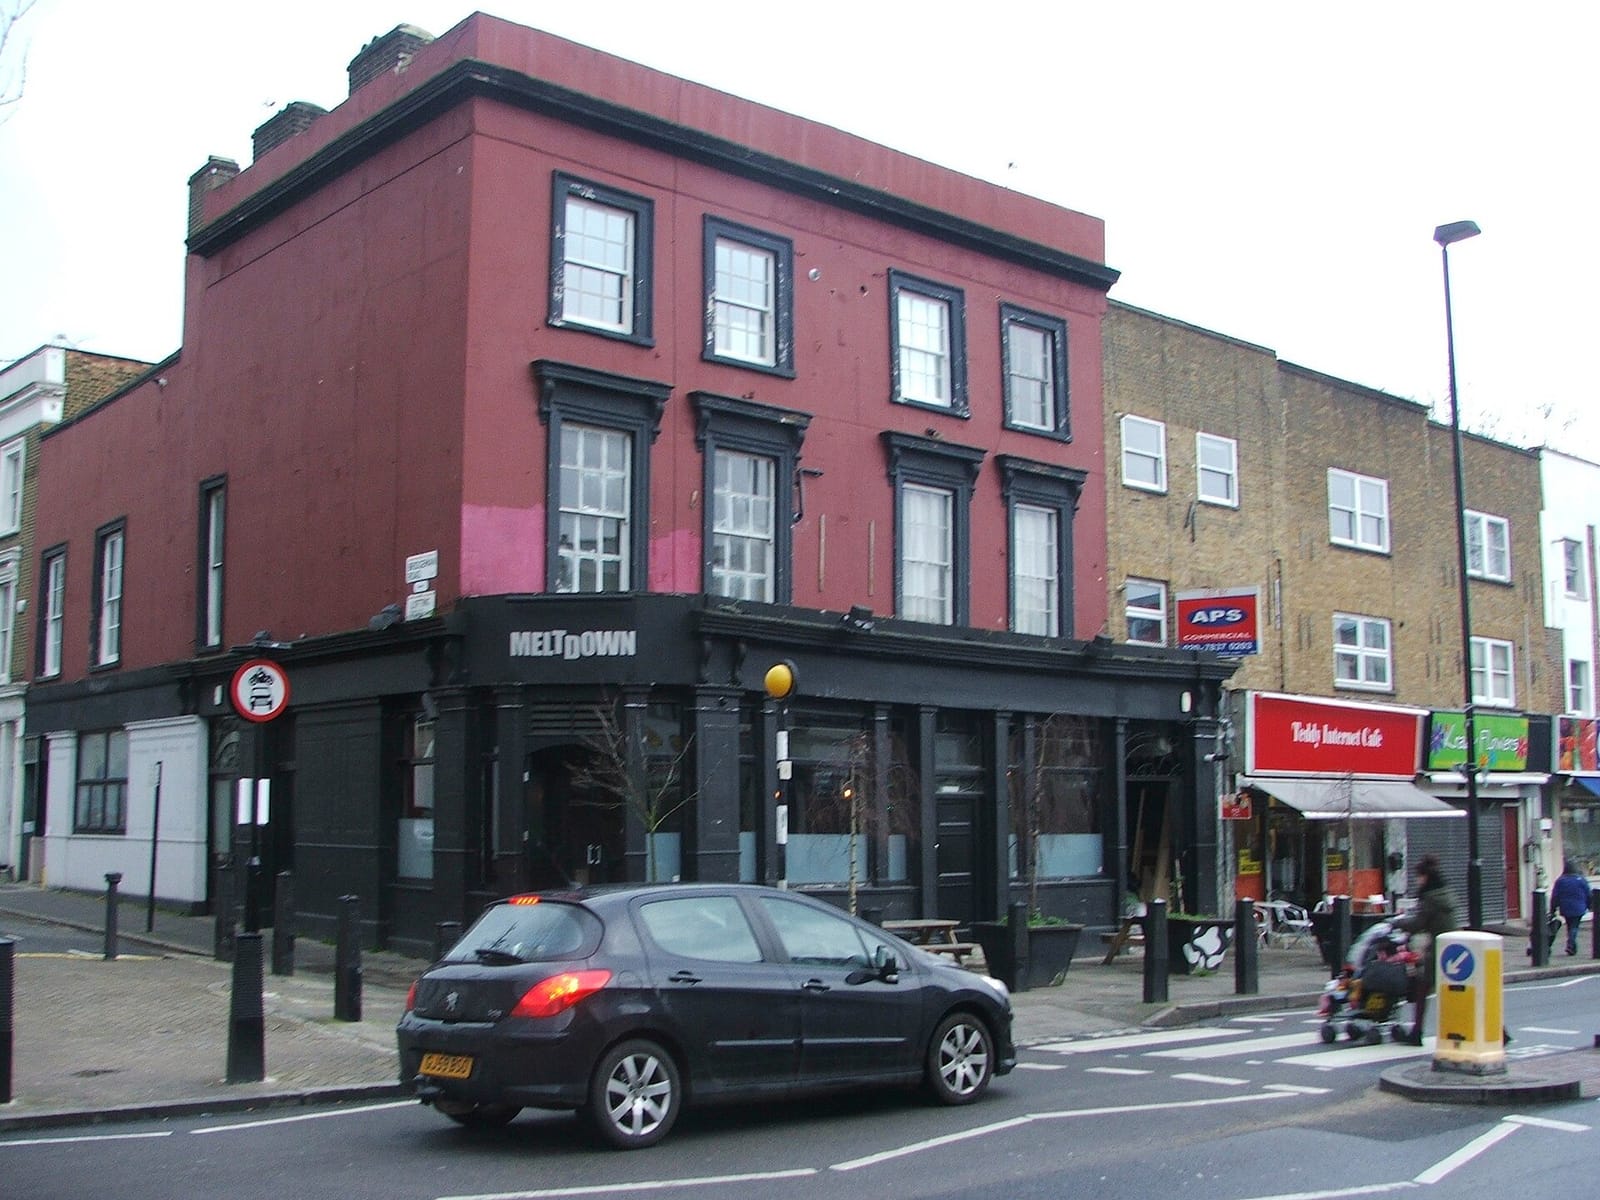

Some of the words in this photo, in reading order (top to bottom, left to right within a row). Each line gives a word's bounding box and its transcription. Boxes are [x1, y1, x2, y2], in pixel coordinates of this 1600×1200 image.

[1191, 609, 1242, 624] APS
[509, 629, 637, 660] MELTDOWN
[1182, 632, 1252, 641] COMMERCIAL
[1291, 721, 1320, 749] Teddy
[1322, 724, 1361, 746] Internet
